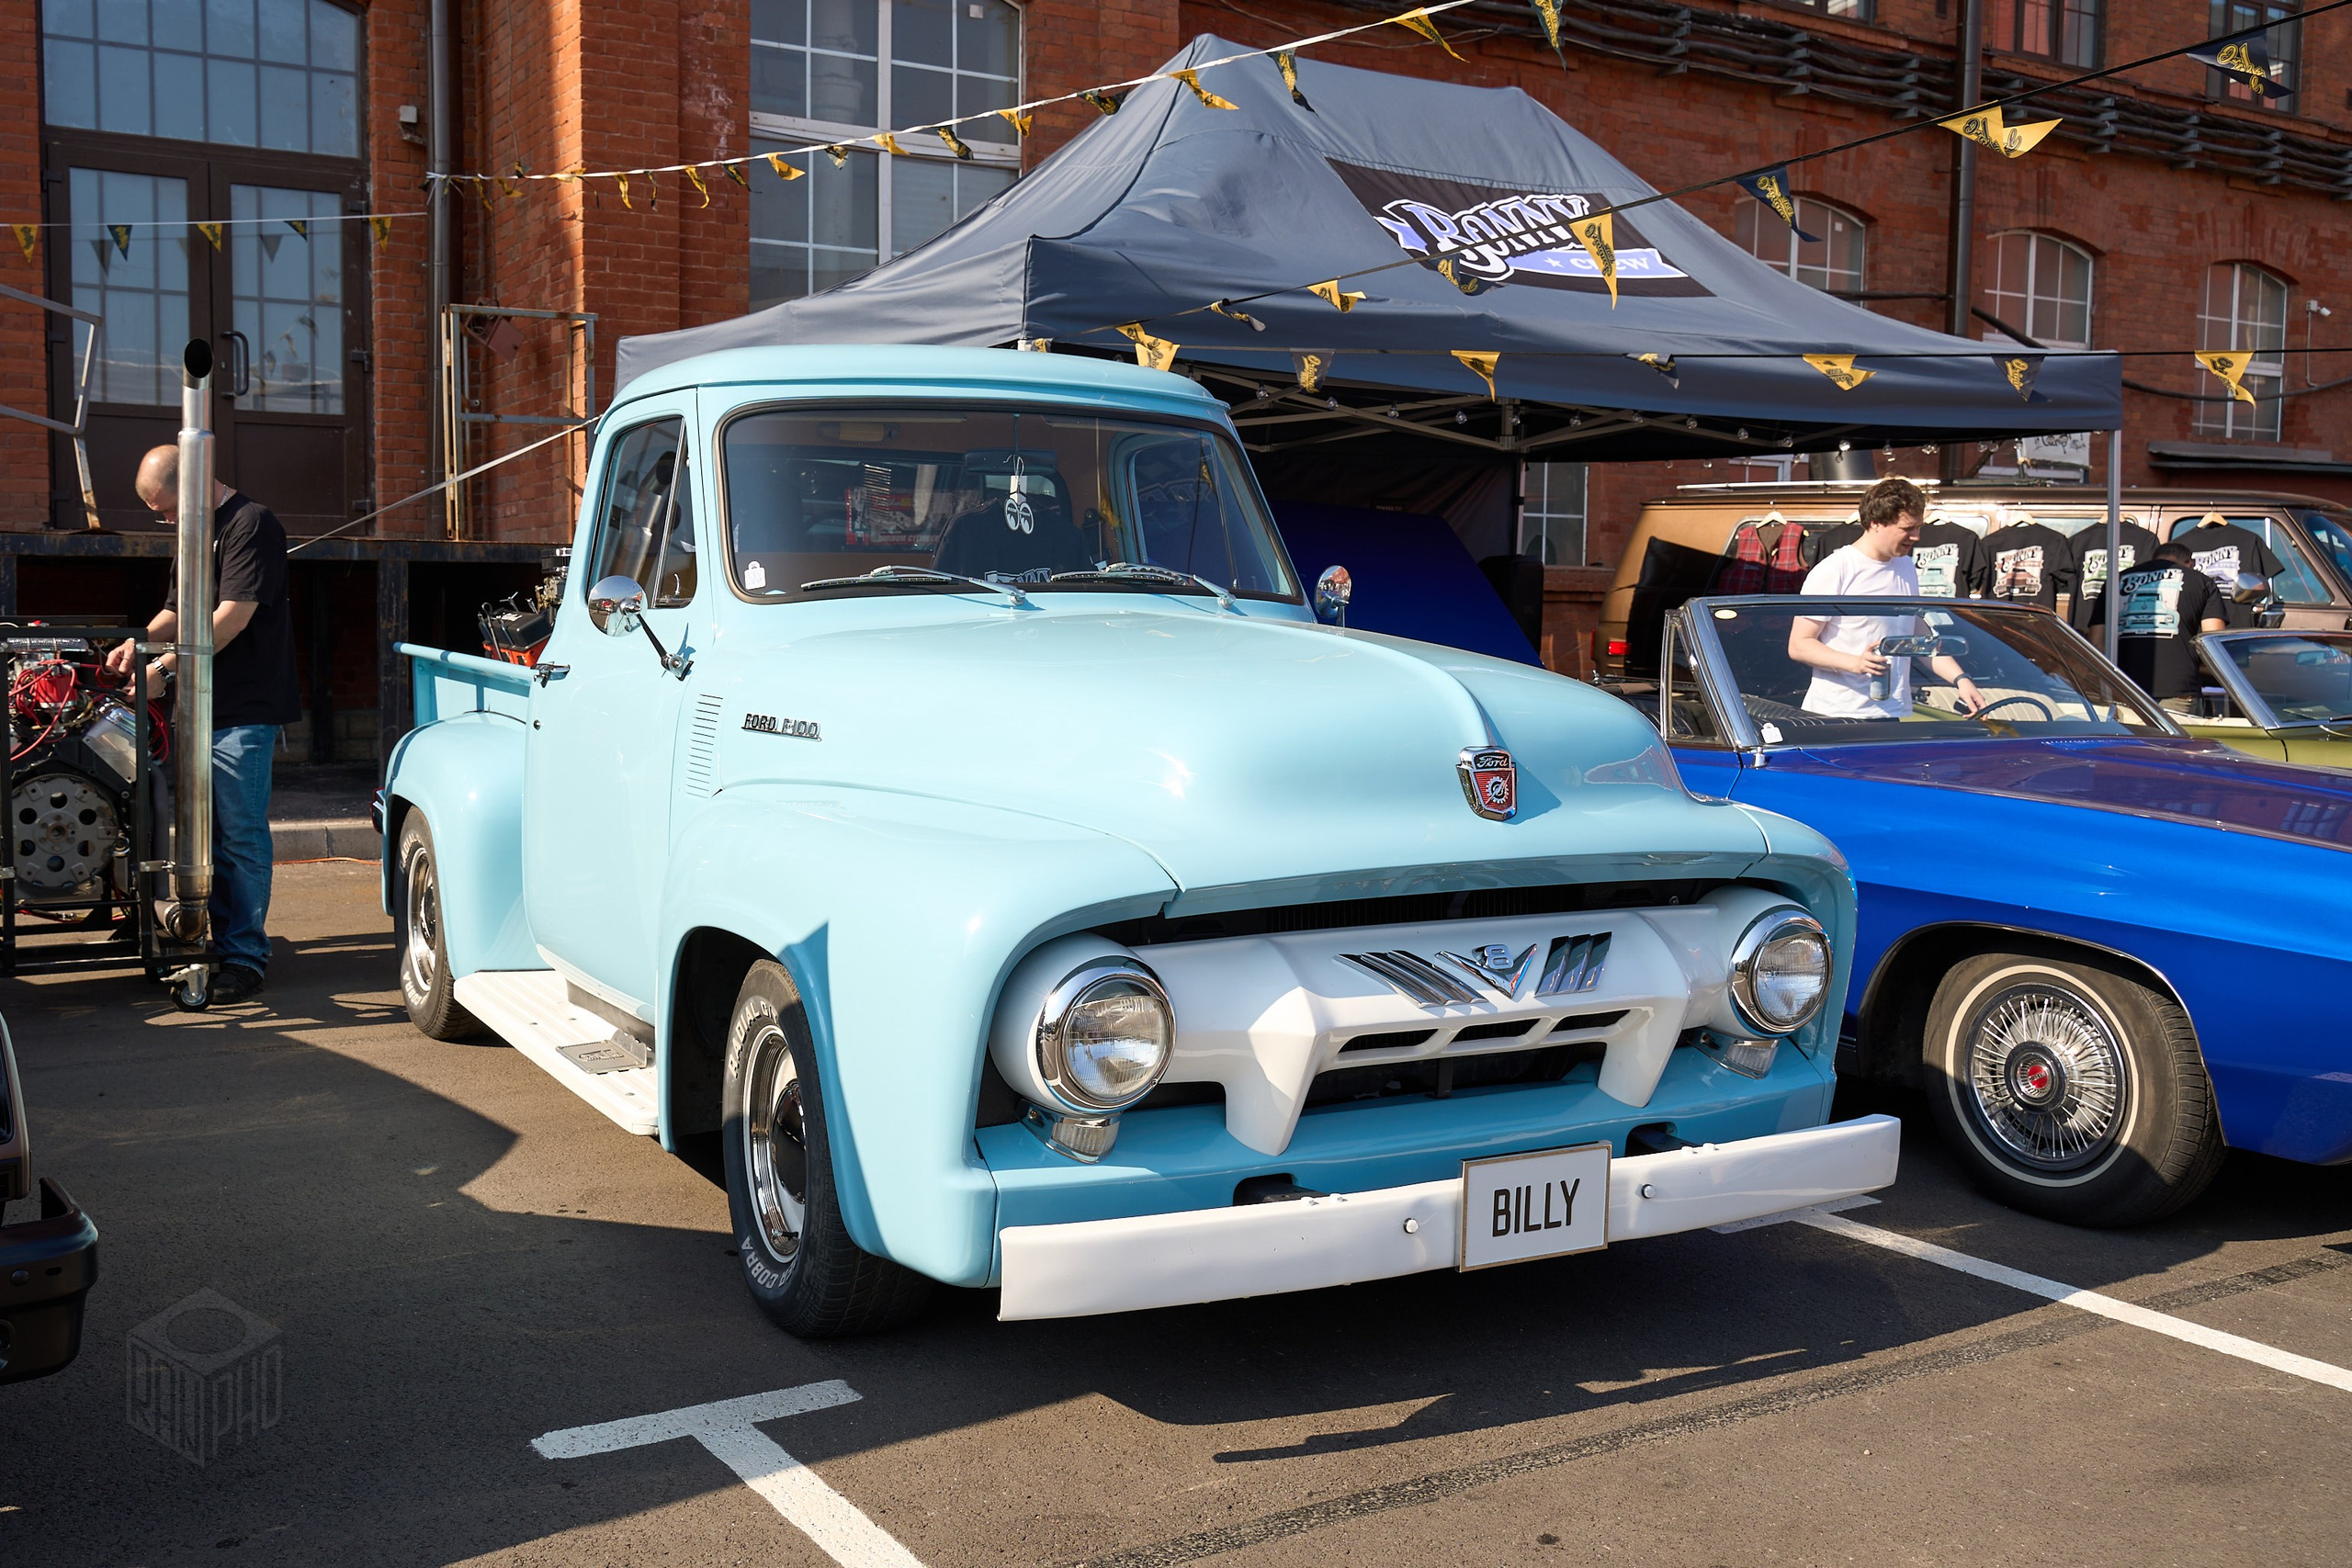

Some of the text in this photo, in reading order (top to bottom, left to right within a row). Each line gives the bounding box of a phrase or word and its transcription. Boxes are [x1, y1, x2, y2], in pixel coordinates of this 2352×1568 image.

[1916, 544, 1955, 570] BONNY
[2001, 547, 2040, 573] BONNY
[2120, 570, 2177, 596] BONNY
[744, 713, 777, 731] FORD
[1476, 755, 1509, 767] Ford
[728, 1001, 760, 1078] RADIAL
[1492, 1178, 1580, 1237] BILLY
[741, 1235, 779, 1290] COBRA
